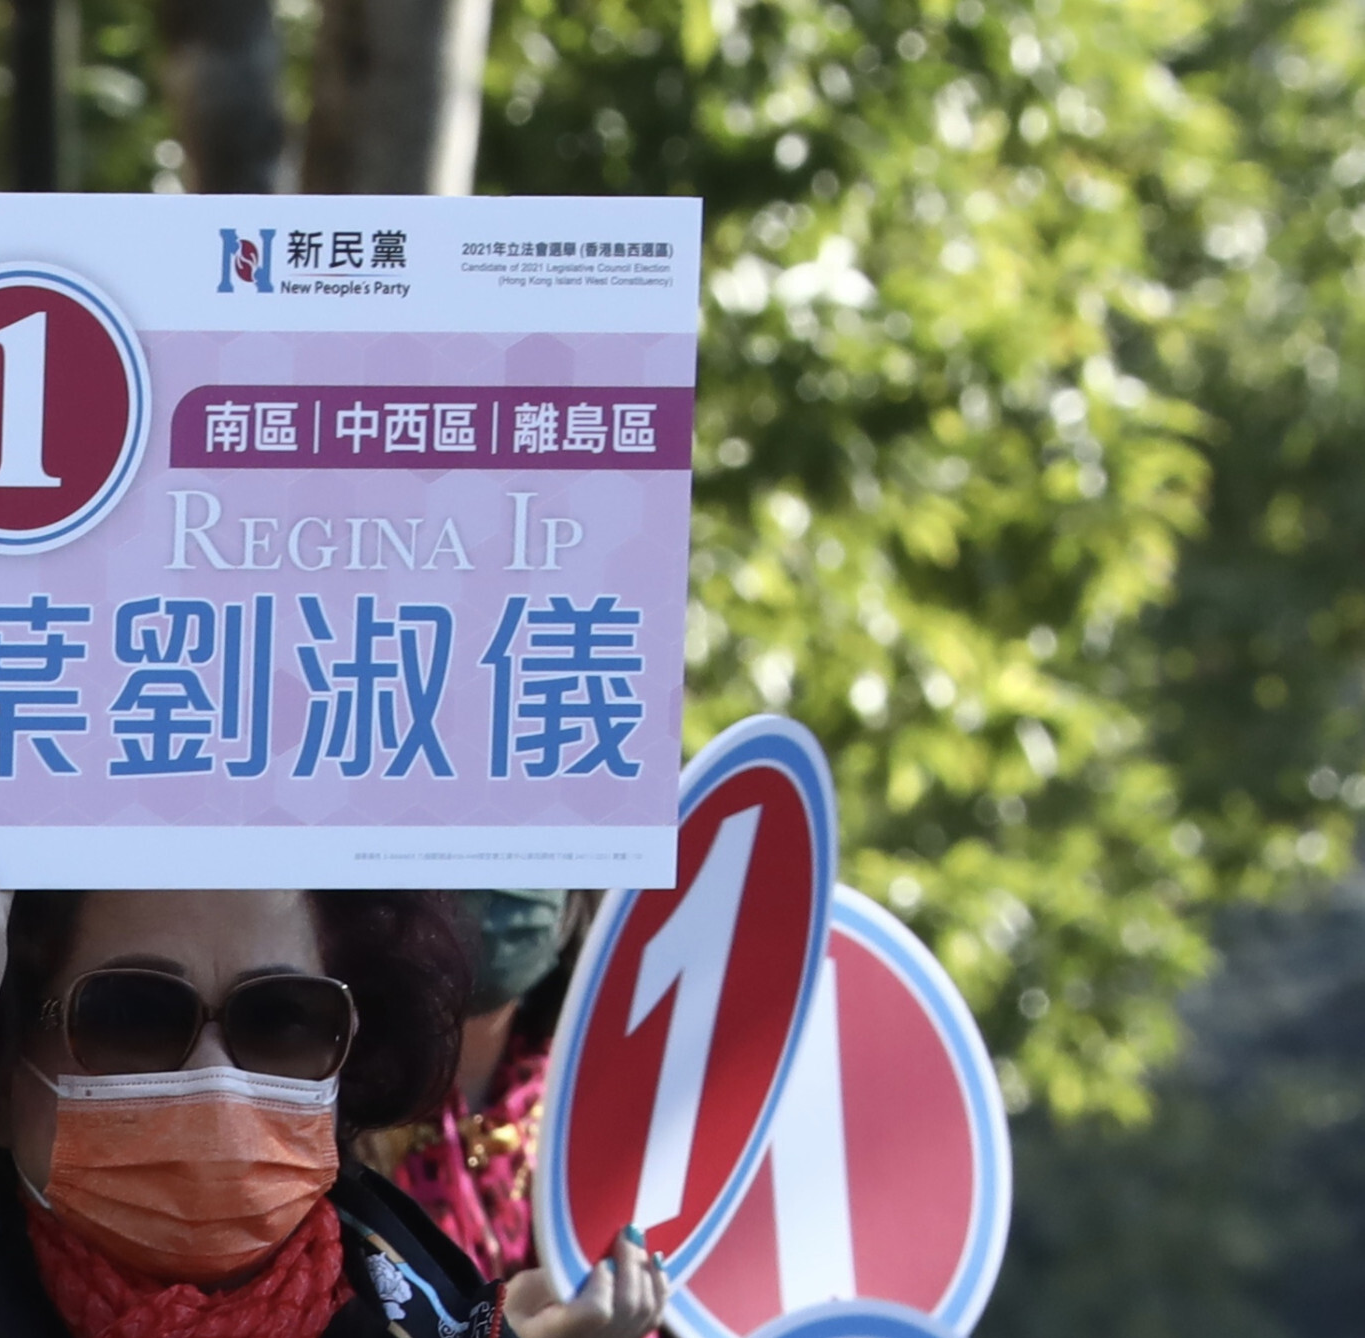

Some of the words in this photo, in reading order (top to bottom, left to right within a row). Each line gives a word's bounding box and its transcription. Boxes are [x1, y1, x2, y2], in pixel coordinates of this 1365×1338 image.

[287, 229, 407, 269] 新民黨
[461, 241, 576, 258] 2021年立法會選舉
[461, 262, 507, 273] Candidate
[509, 262, 519, 273] of
[521, 262, 544, 273] 2021
[546, 262, 594, 274] Legislative
[596, 262, 631, 273] Council
[634, 262, 670, 273] Election
[280, 281, 311, 295] New
[373, 281, 411, 298] Party
[498, 275, 526, 287] (Hong
[528, 276, 552, 287] Kong
[555, 275, 582, 286] Island
[585, 275, 608, 286] West
[205, 402, 299, 454] 南區
[335, 402, 478, 454] 中西區
[512, 402, 658, 454] 離島區
[624, 804, 761, 1231] 1
